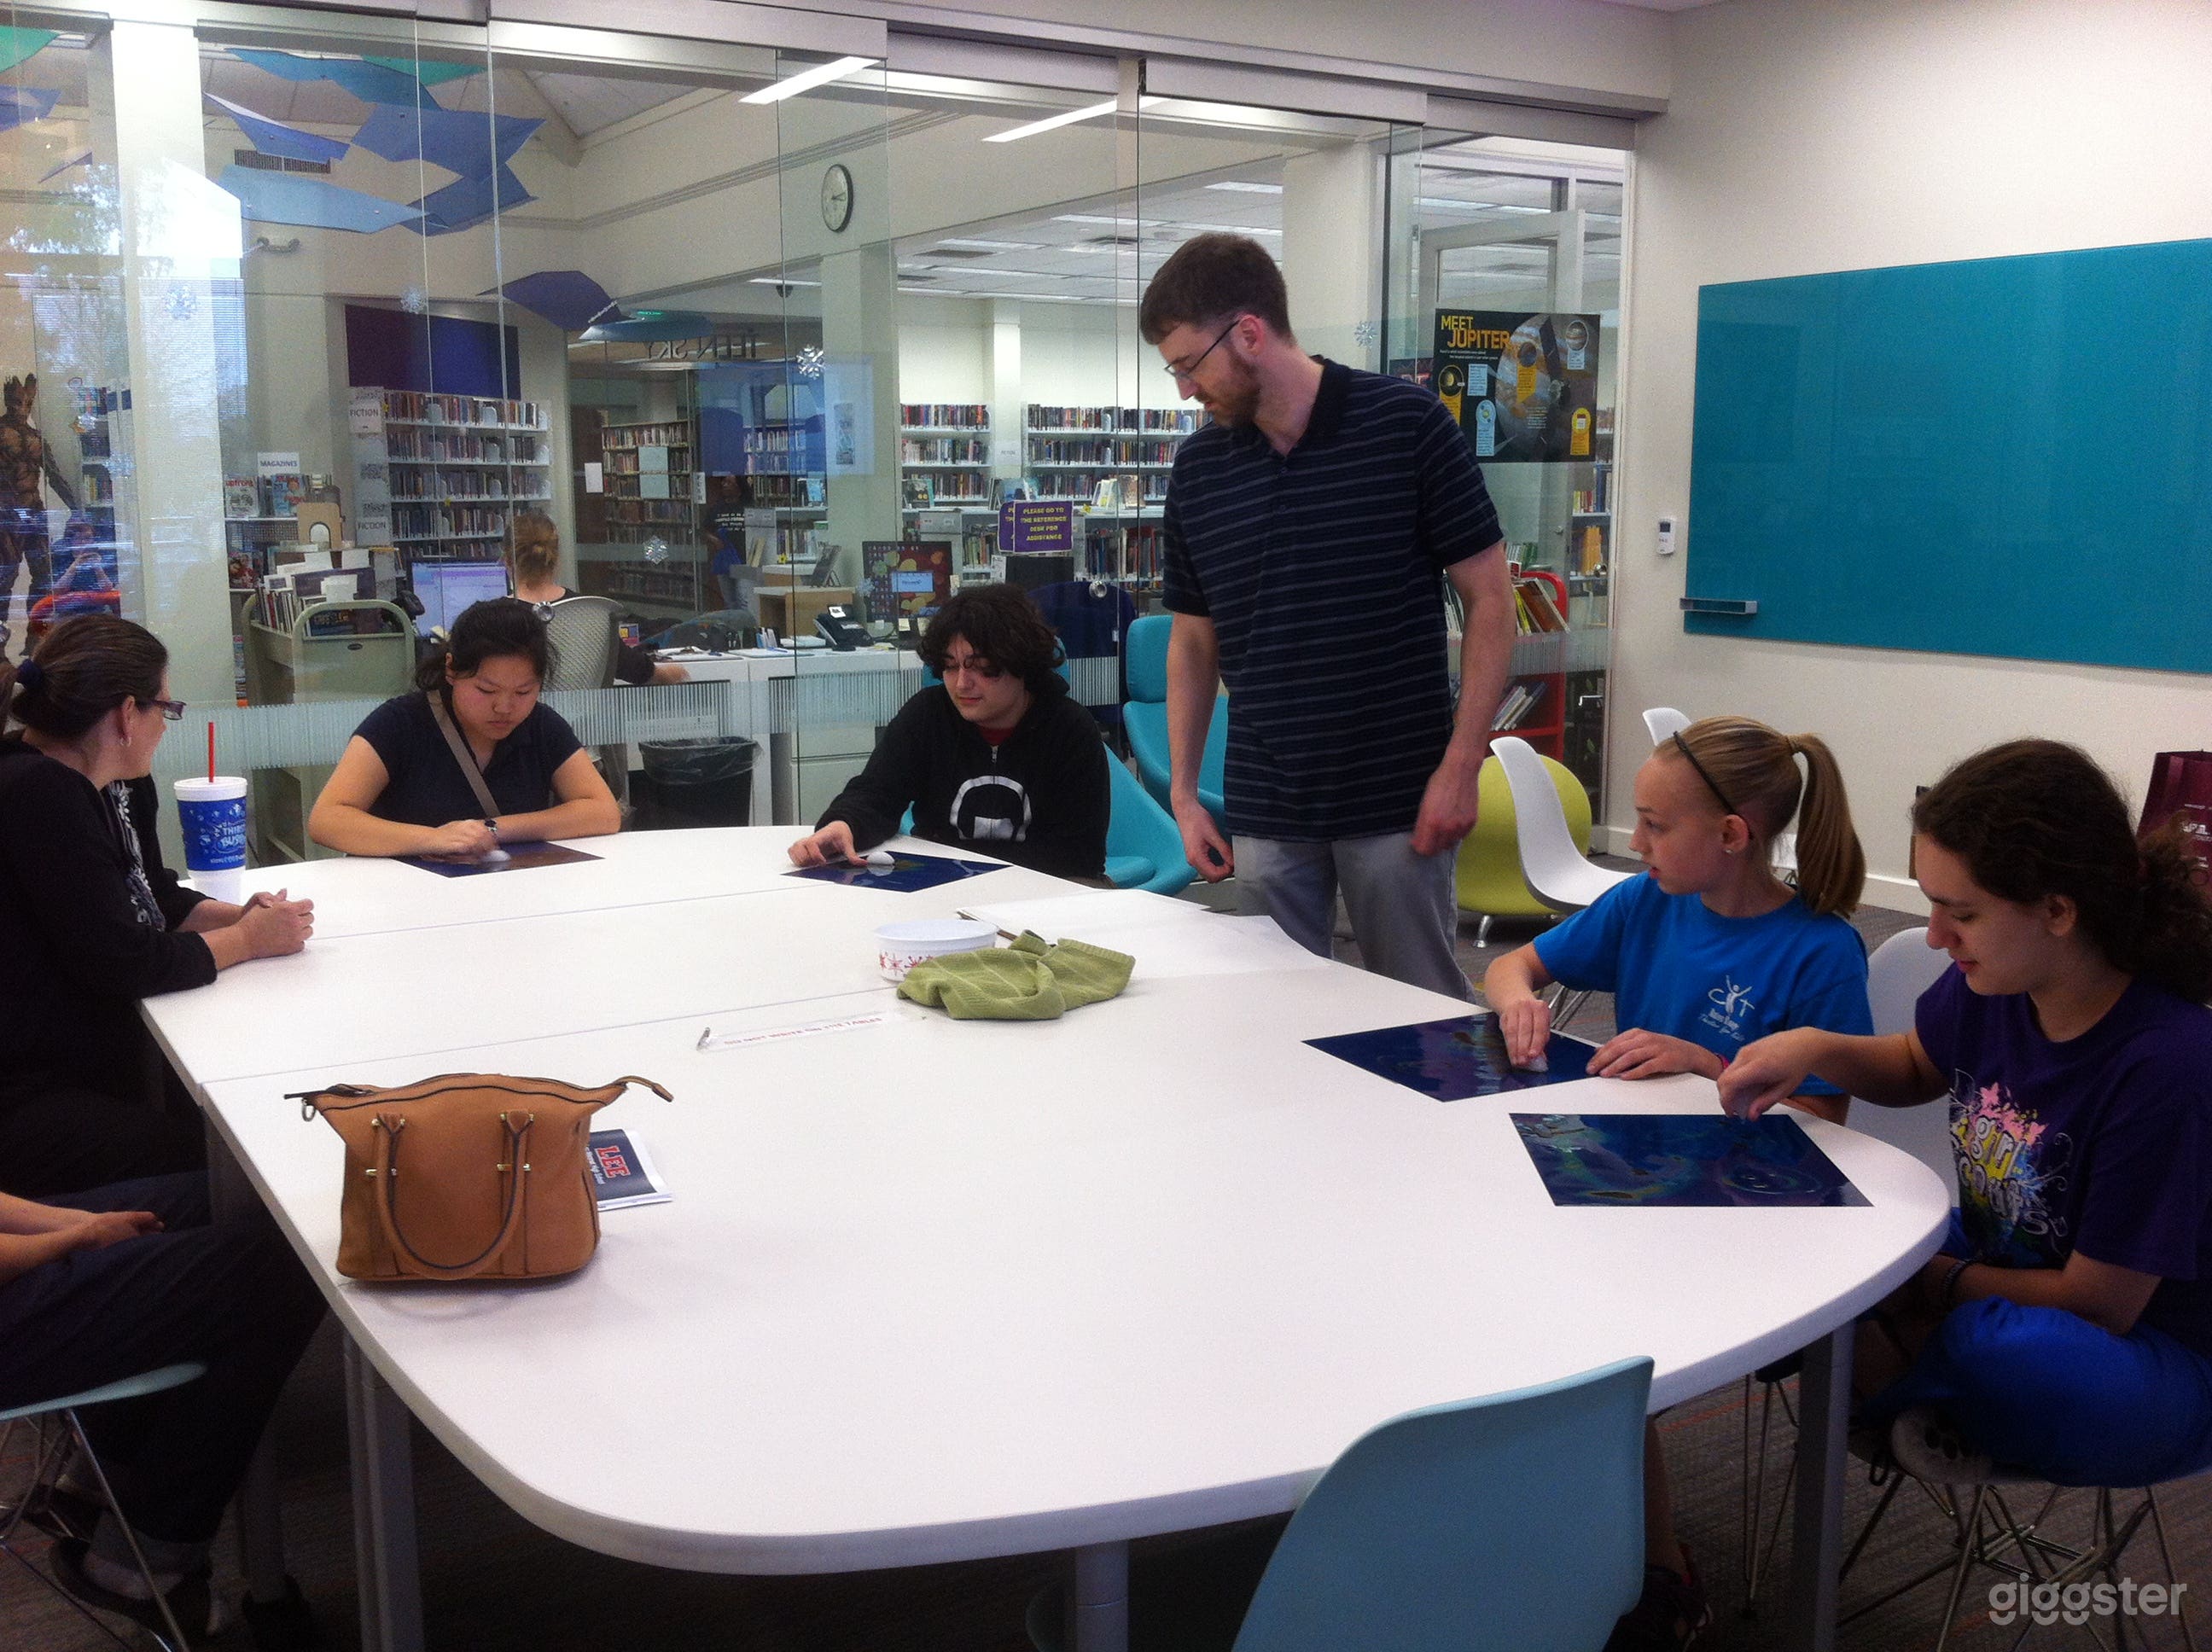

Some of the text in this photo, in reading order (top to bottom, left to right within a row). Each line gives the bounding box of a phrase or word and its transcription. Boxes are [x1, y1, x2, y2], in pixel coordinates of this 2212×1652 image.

[1441, 315, 1474, 330] MEET
[1447, 329, 1511, 349] JUPITER
[349, 408, 379, 417] FICTION
[594, 1145, 632, 1178] LEE
